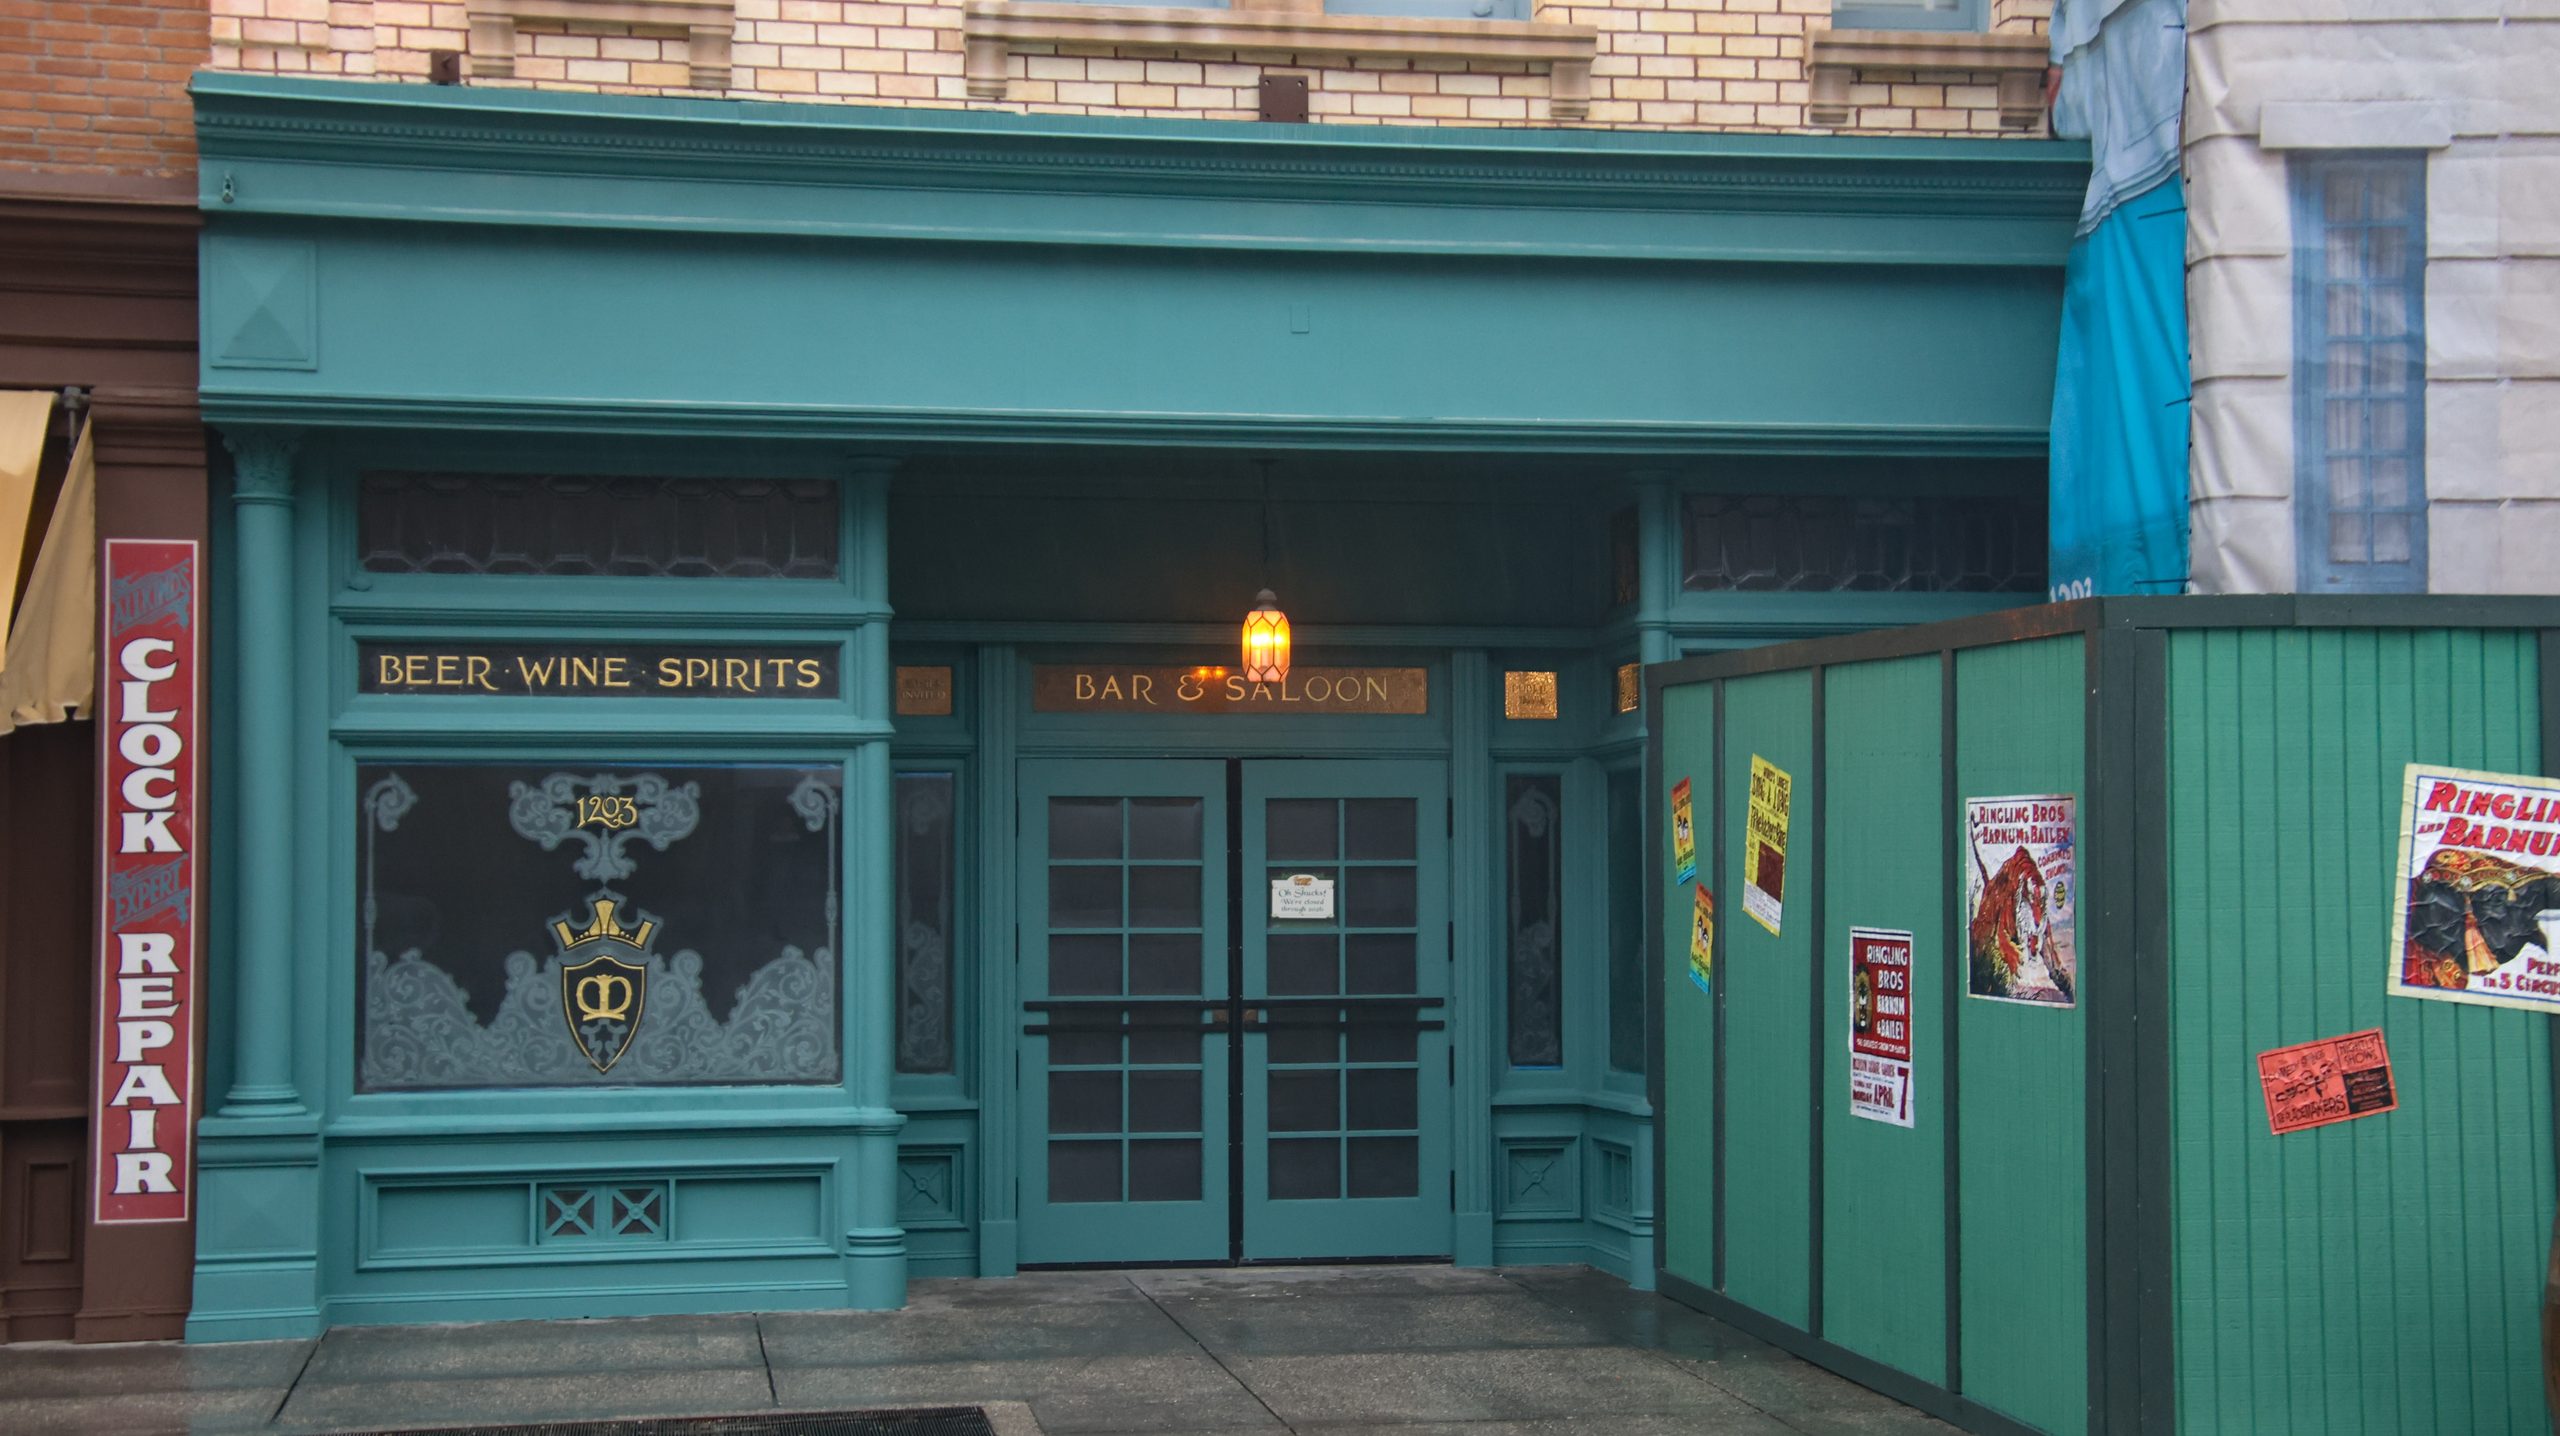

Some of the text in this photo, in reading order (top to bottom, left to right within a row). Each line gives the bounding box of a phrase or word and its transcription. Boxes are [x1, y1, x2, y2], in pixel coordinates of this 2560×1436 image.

[379, 655, 822, 693] BEER WINE SPIRITS
[1075, 674, 1388, 705] BAR & SALOON
[118, 637, 184, 854] CLOCK
[576, 795, 639, 829] 1203
[1979, 803, 2066, 824] RINGLING BROS
[1982, 825, 2024, 845] BARNUM
[2030, 825, 2071, 844] BAILEY
[114, 862, 181, 921] EXPERT
[1867, 945, 1908, 966] RINGLING
[1878, 969, 1904, 991] BROS
[1876, 994, 1905, 1015] BARNUM
[2339, 1036, 2377, 1055] NIGHTLY
[2343, 1050, 2378, 1067] SHOWS
[110, 931, 183, 1195] REPAIR
[1874, 1083, 1894, 1109] APRIL
[1898, 1066, 1909, 1121] 7
